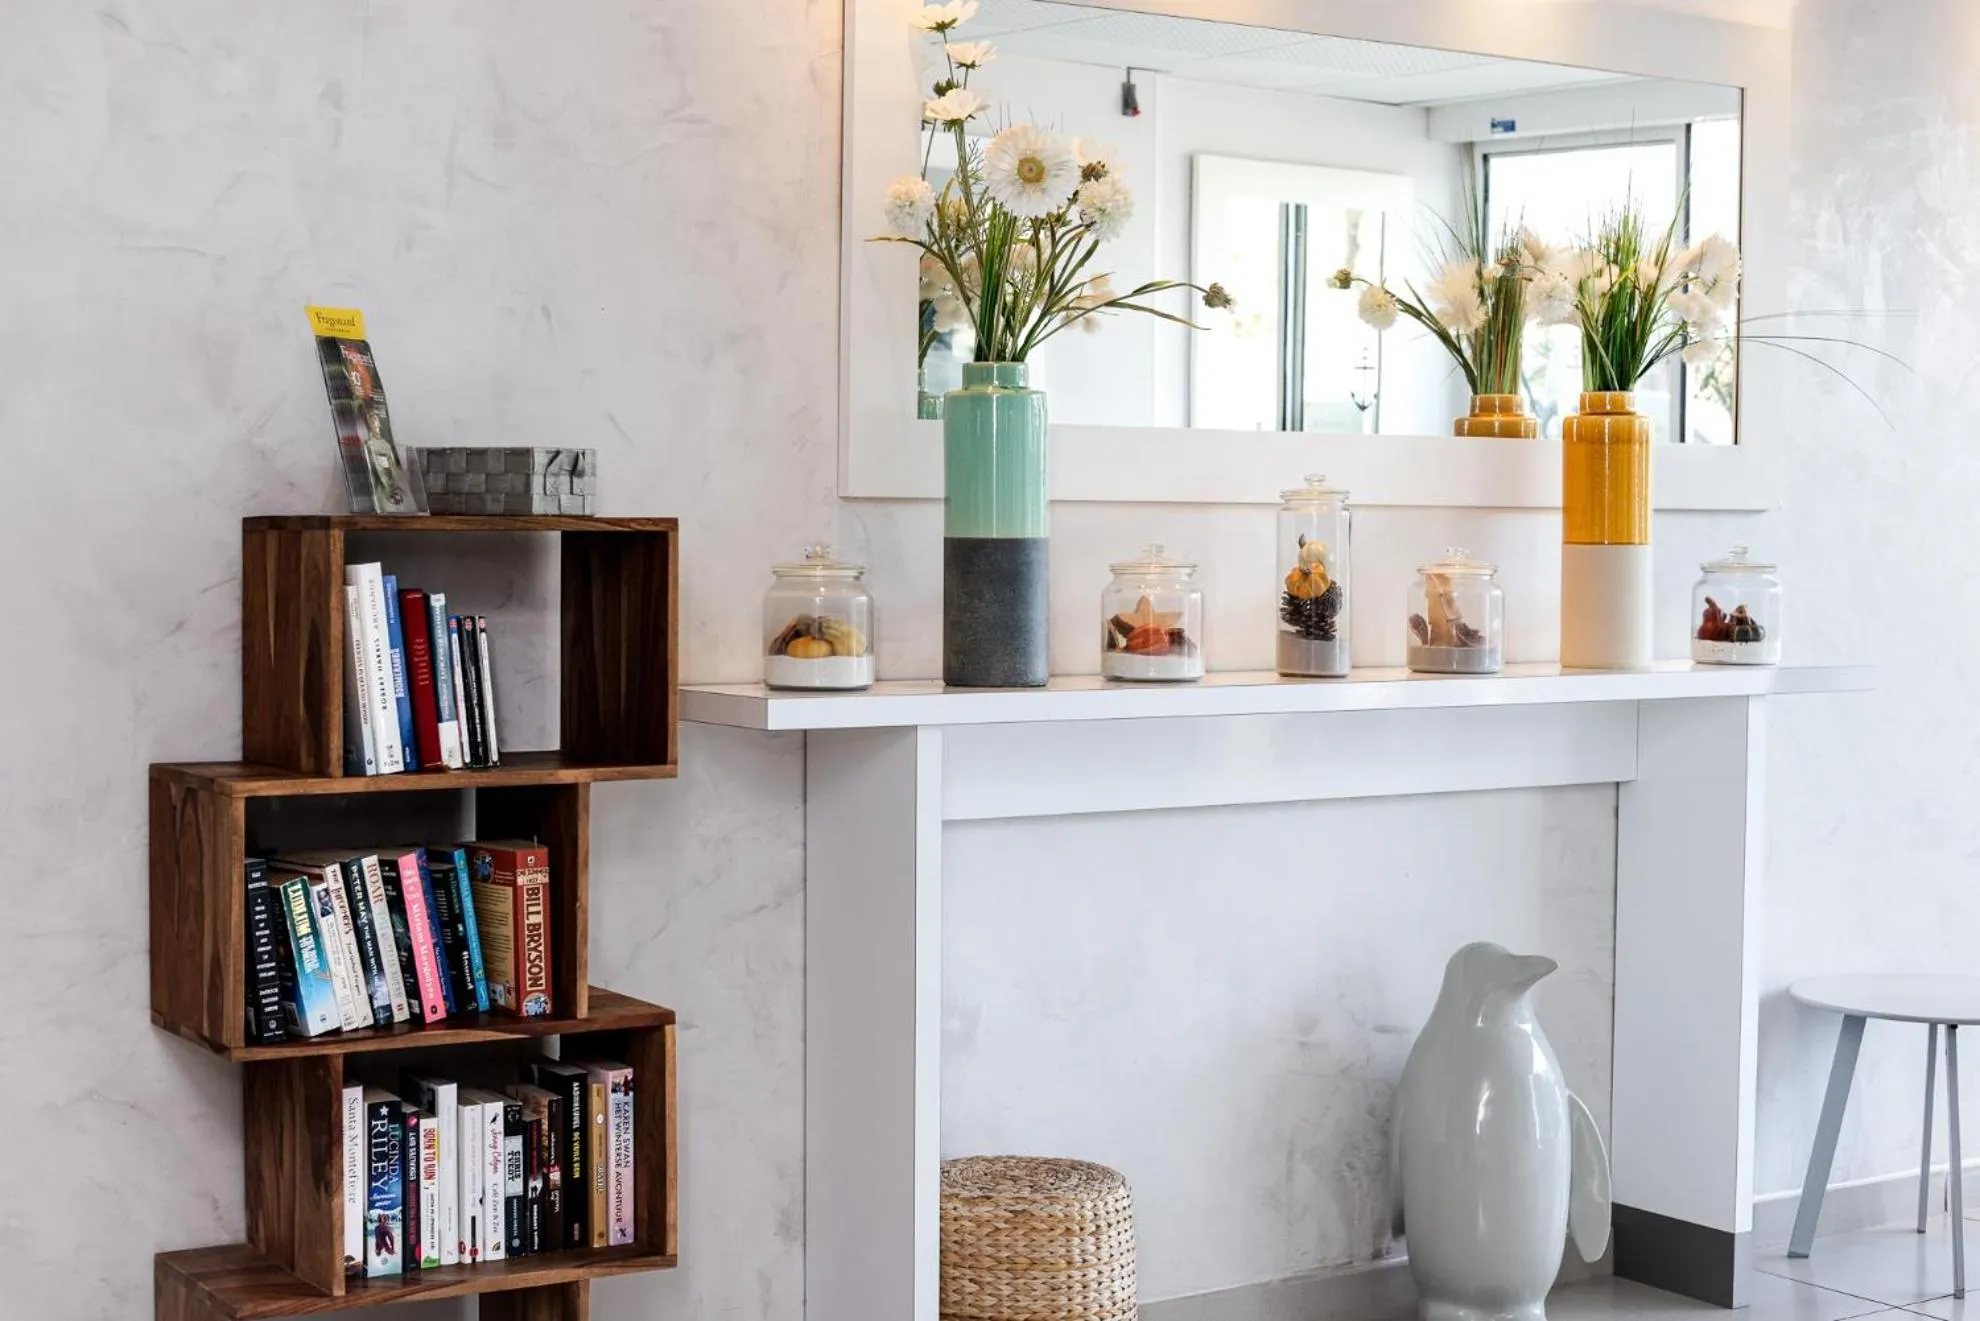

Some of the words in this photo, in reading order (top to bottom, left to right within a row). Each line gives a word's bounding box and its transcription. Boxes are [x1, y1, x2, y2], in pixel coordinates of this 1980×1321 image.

[351, 865, 363, 900] PETER
[366, 863, 385, 905] ROAR
[287, 884, 311, 937] LUDLUM
[356, 901, 368, 924] MAY
[525, 886, 540, 920] BILL
[361, 927, 370, 939] THE
[411, 903, 426, 942] Miriam
[364, 941, 374, 957] MAN
[526, 922, 543, 988] BRYSON
[369, 958, 377, 976] WITH
[347, 1097, 359, 1131] Santa
[623, 1101, 631, 1134] KAREN
[371, 1119, 388, 1190] RILEY
[388, 1124, 399, 1184] LUCINDA
[423, 1128, 436, 1149] BORN
[491, 1128, 503, 1150] Jenny
[623, 1138, 631, 1168] SWAN
[348, 1134, 360, 1204] Montefiore
[423, 1164, 436, 1180] RUN
[424, 1151, 435, 1162] TO
